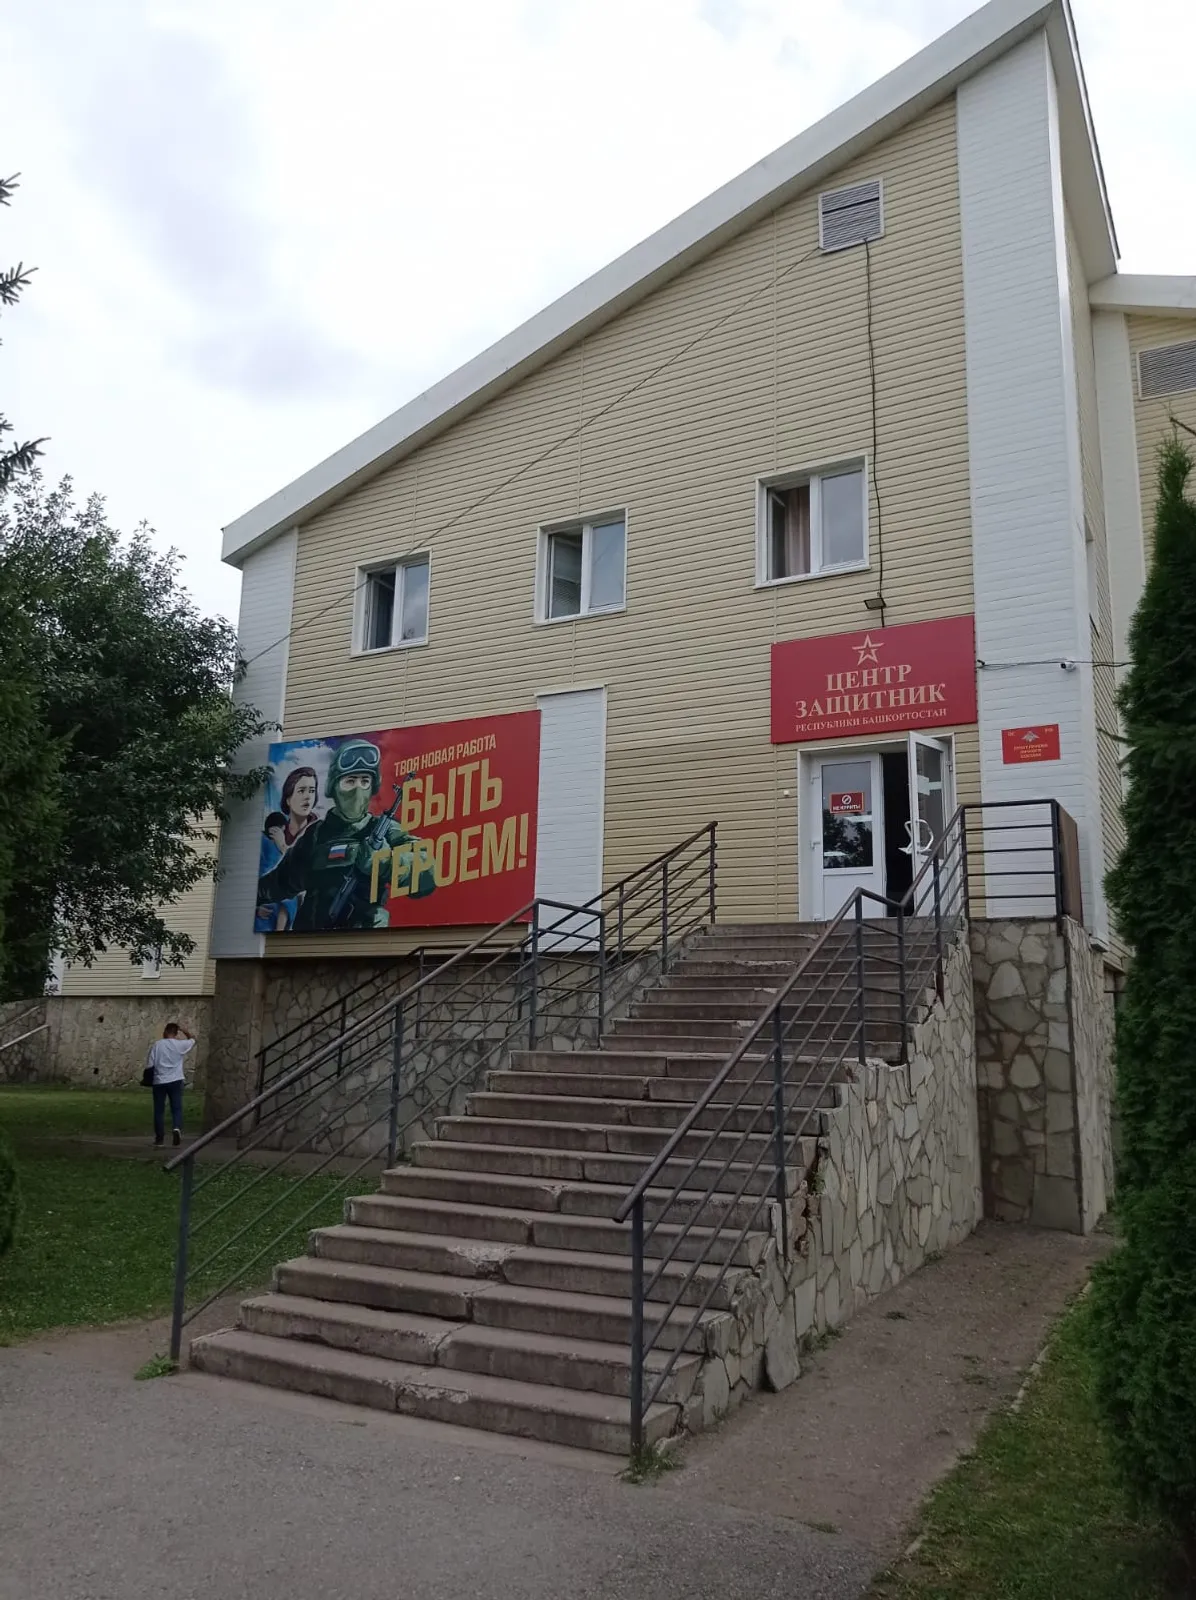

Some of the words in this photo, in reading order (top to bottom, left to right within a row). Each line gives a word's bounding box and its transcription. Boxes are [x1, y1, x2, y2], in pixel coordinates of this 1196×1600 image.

[824, 664, 912, 693] ЦЕНТР
[795, 683, 946, 719] ЗАЩИТНИК
[795, 717, 861, 733] РЕСПУБЛИКИ
[862, 708, 947, 725] БАШКОРТОСТАН
[394, 756, 420, 777] ТВОЯ
[420, 746, 455, 770] НОВАЯ
[456, 733, 497, 760] РАБОТА
[400, 758, 503, 832] БЫТЬ
[369, 813, 529, 904] ГЕРОЕМ!
